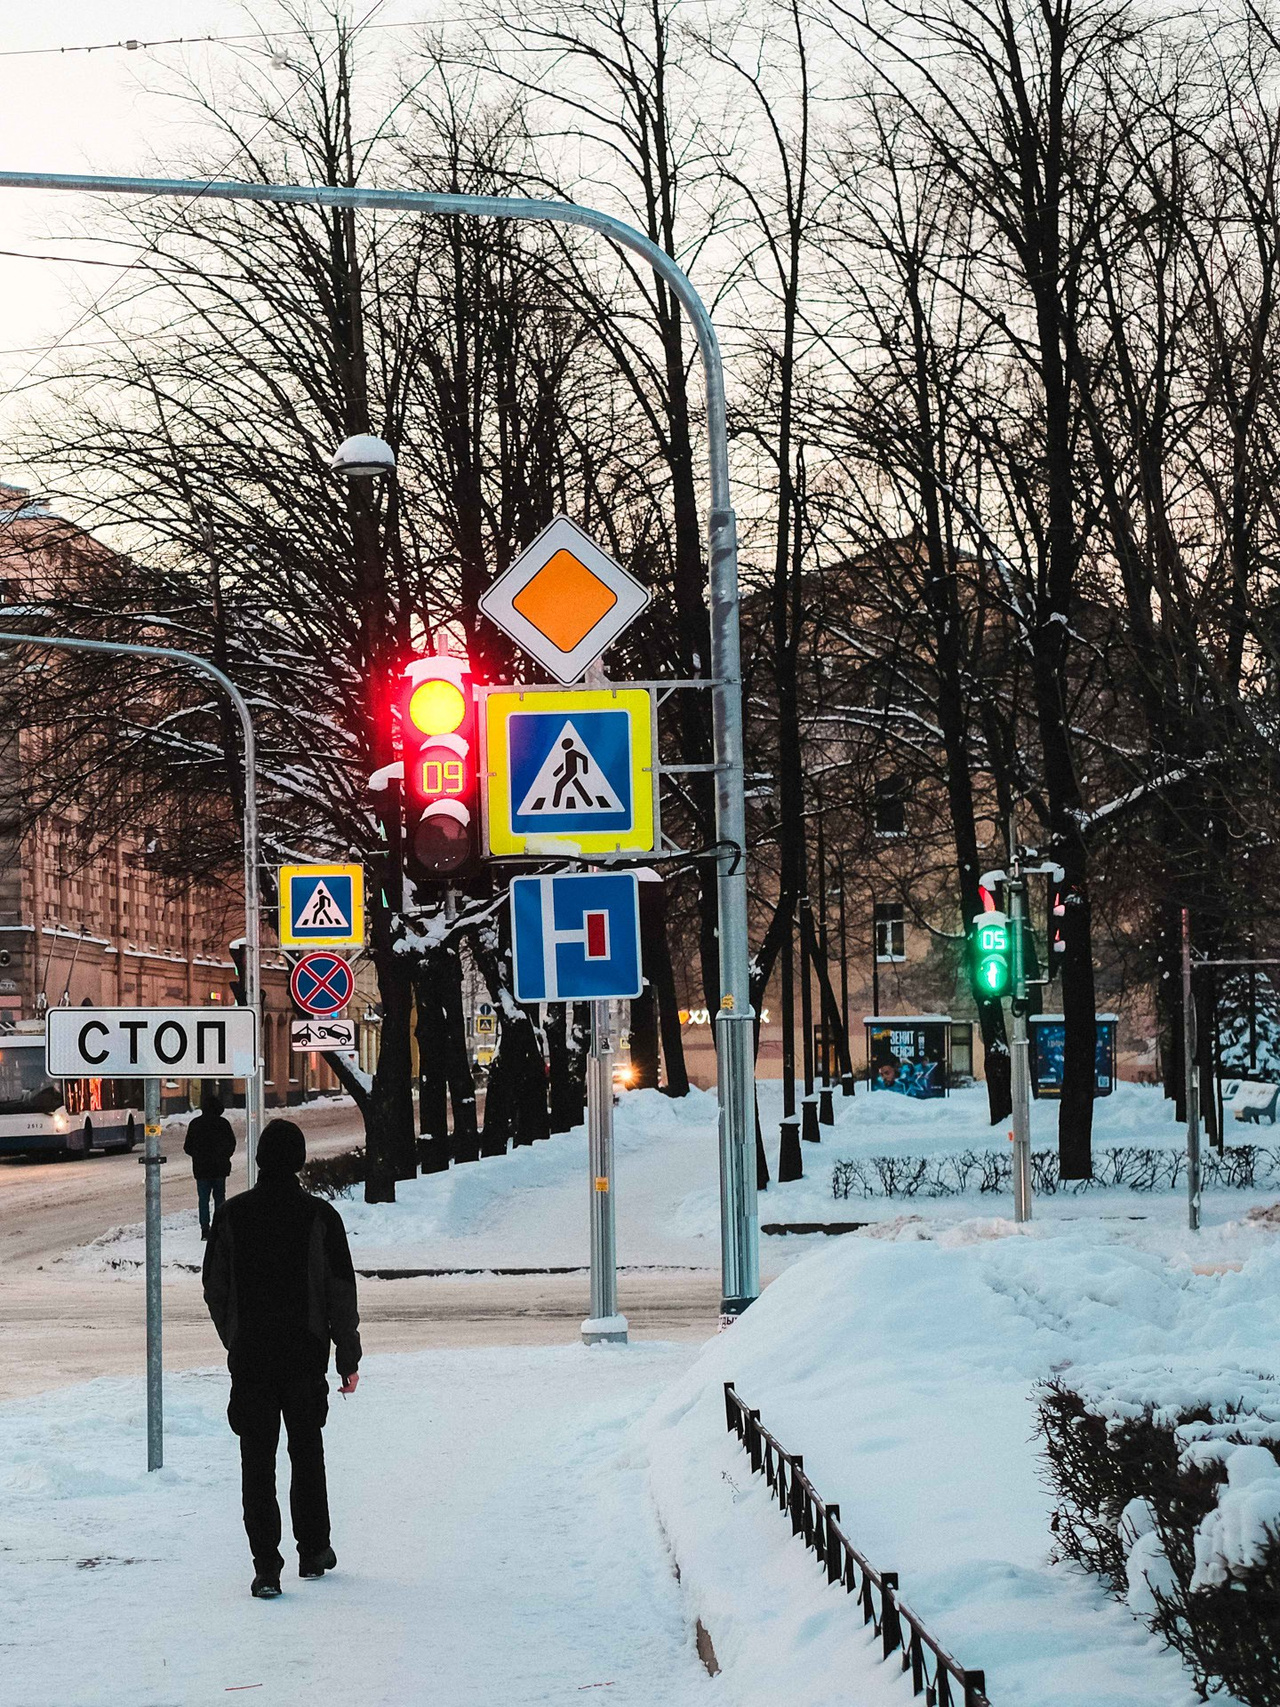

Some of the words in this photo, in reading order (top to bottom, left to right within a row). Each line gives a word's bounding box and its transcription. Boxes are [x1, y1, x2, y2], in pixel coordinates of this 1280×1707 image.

[422, 761, 463, 794] 09
[982, 930, 1006, 950] 05
[77, 1020, 226, 1065] СТОП
[890, 1030, 915, 1045] ЗЕНИТ
